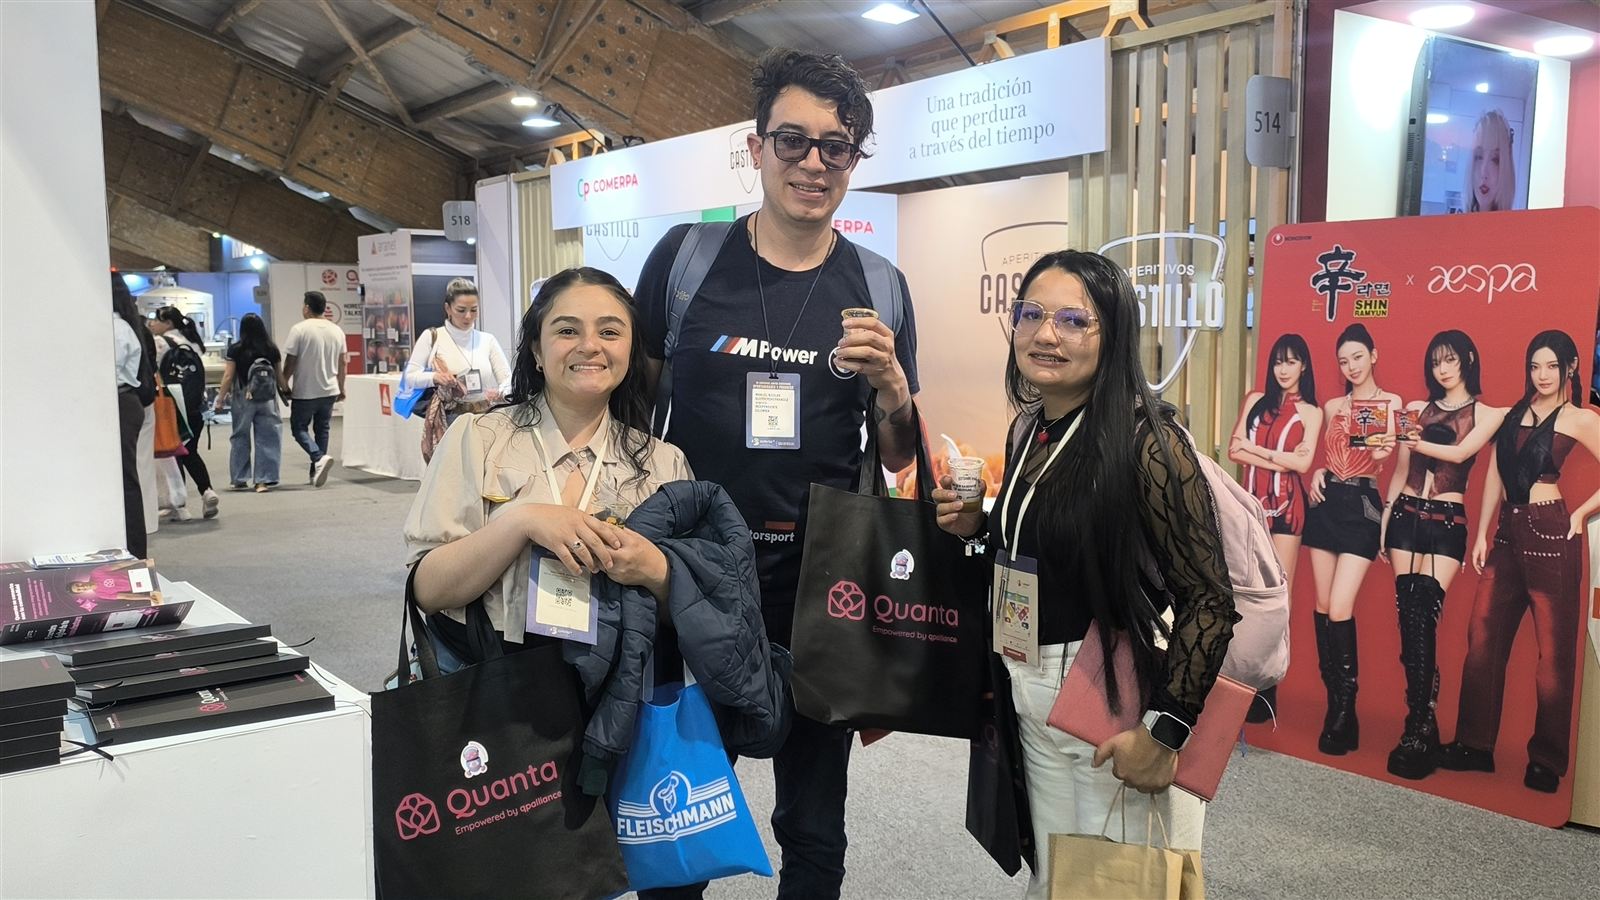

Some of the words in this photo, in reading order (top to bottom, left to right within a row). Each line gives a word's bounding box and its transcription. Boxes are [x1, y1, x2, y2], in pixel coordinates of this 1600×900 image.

[927, 95, 955, 114] Una
[959, 77, 1032, 108] tradición
[931, 118, 959, 137] que
[963, 103, 1027, 133] perdura
[1254, 110, 1281, 134] 514
[909, 146, 917, 160] a
[920, 134, 965, 157] través
[968, 128, 992, 150] del
[997, 122, 1055, 145] tiempo
[593, 173, 639, 193] COMERPA
[451, 215, 471, 226] 518
[586, 220, 639, 238] CASTILLO
[1311, 244, 1366, 321] 辛
[1357, 282, 1391, 297] 라면
[1427, 263, 1538, 304] aespa
[1355, 300, 1387, 310] SHIN
[730, 337, 757, 357] M
[759, 341, 818, 365] Power
[873, 595, 959, 626] Quanta
[872, 625, 915, 639] Empowered
[917, 632, 927, 641] by
[446, 760, 558, 819] Quanta
[455, 811, 506, 835] Empowered
[507, 808, 519, 818] by
[519, 790, 562, 813] qpalliance
[617, 793, 736, 836] FLEISCHMANN
